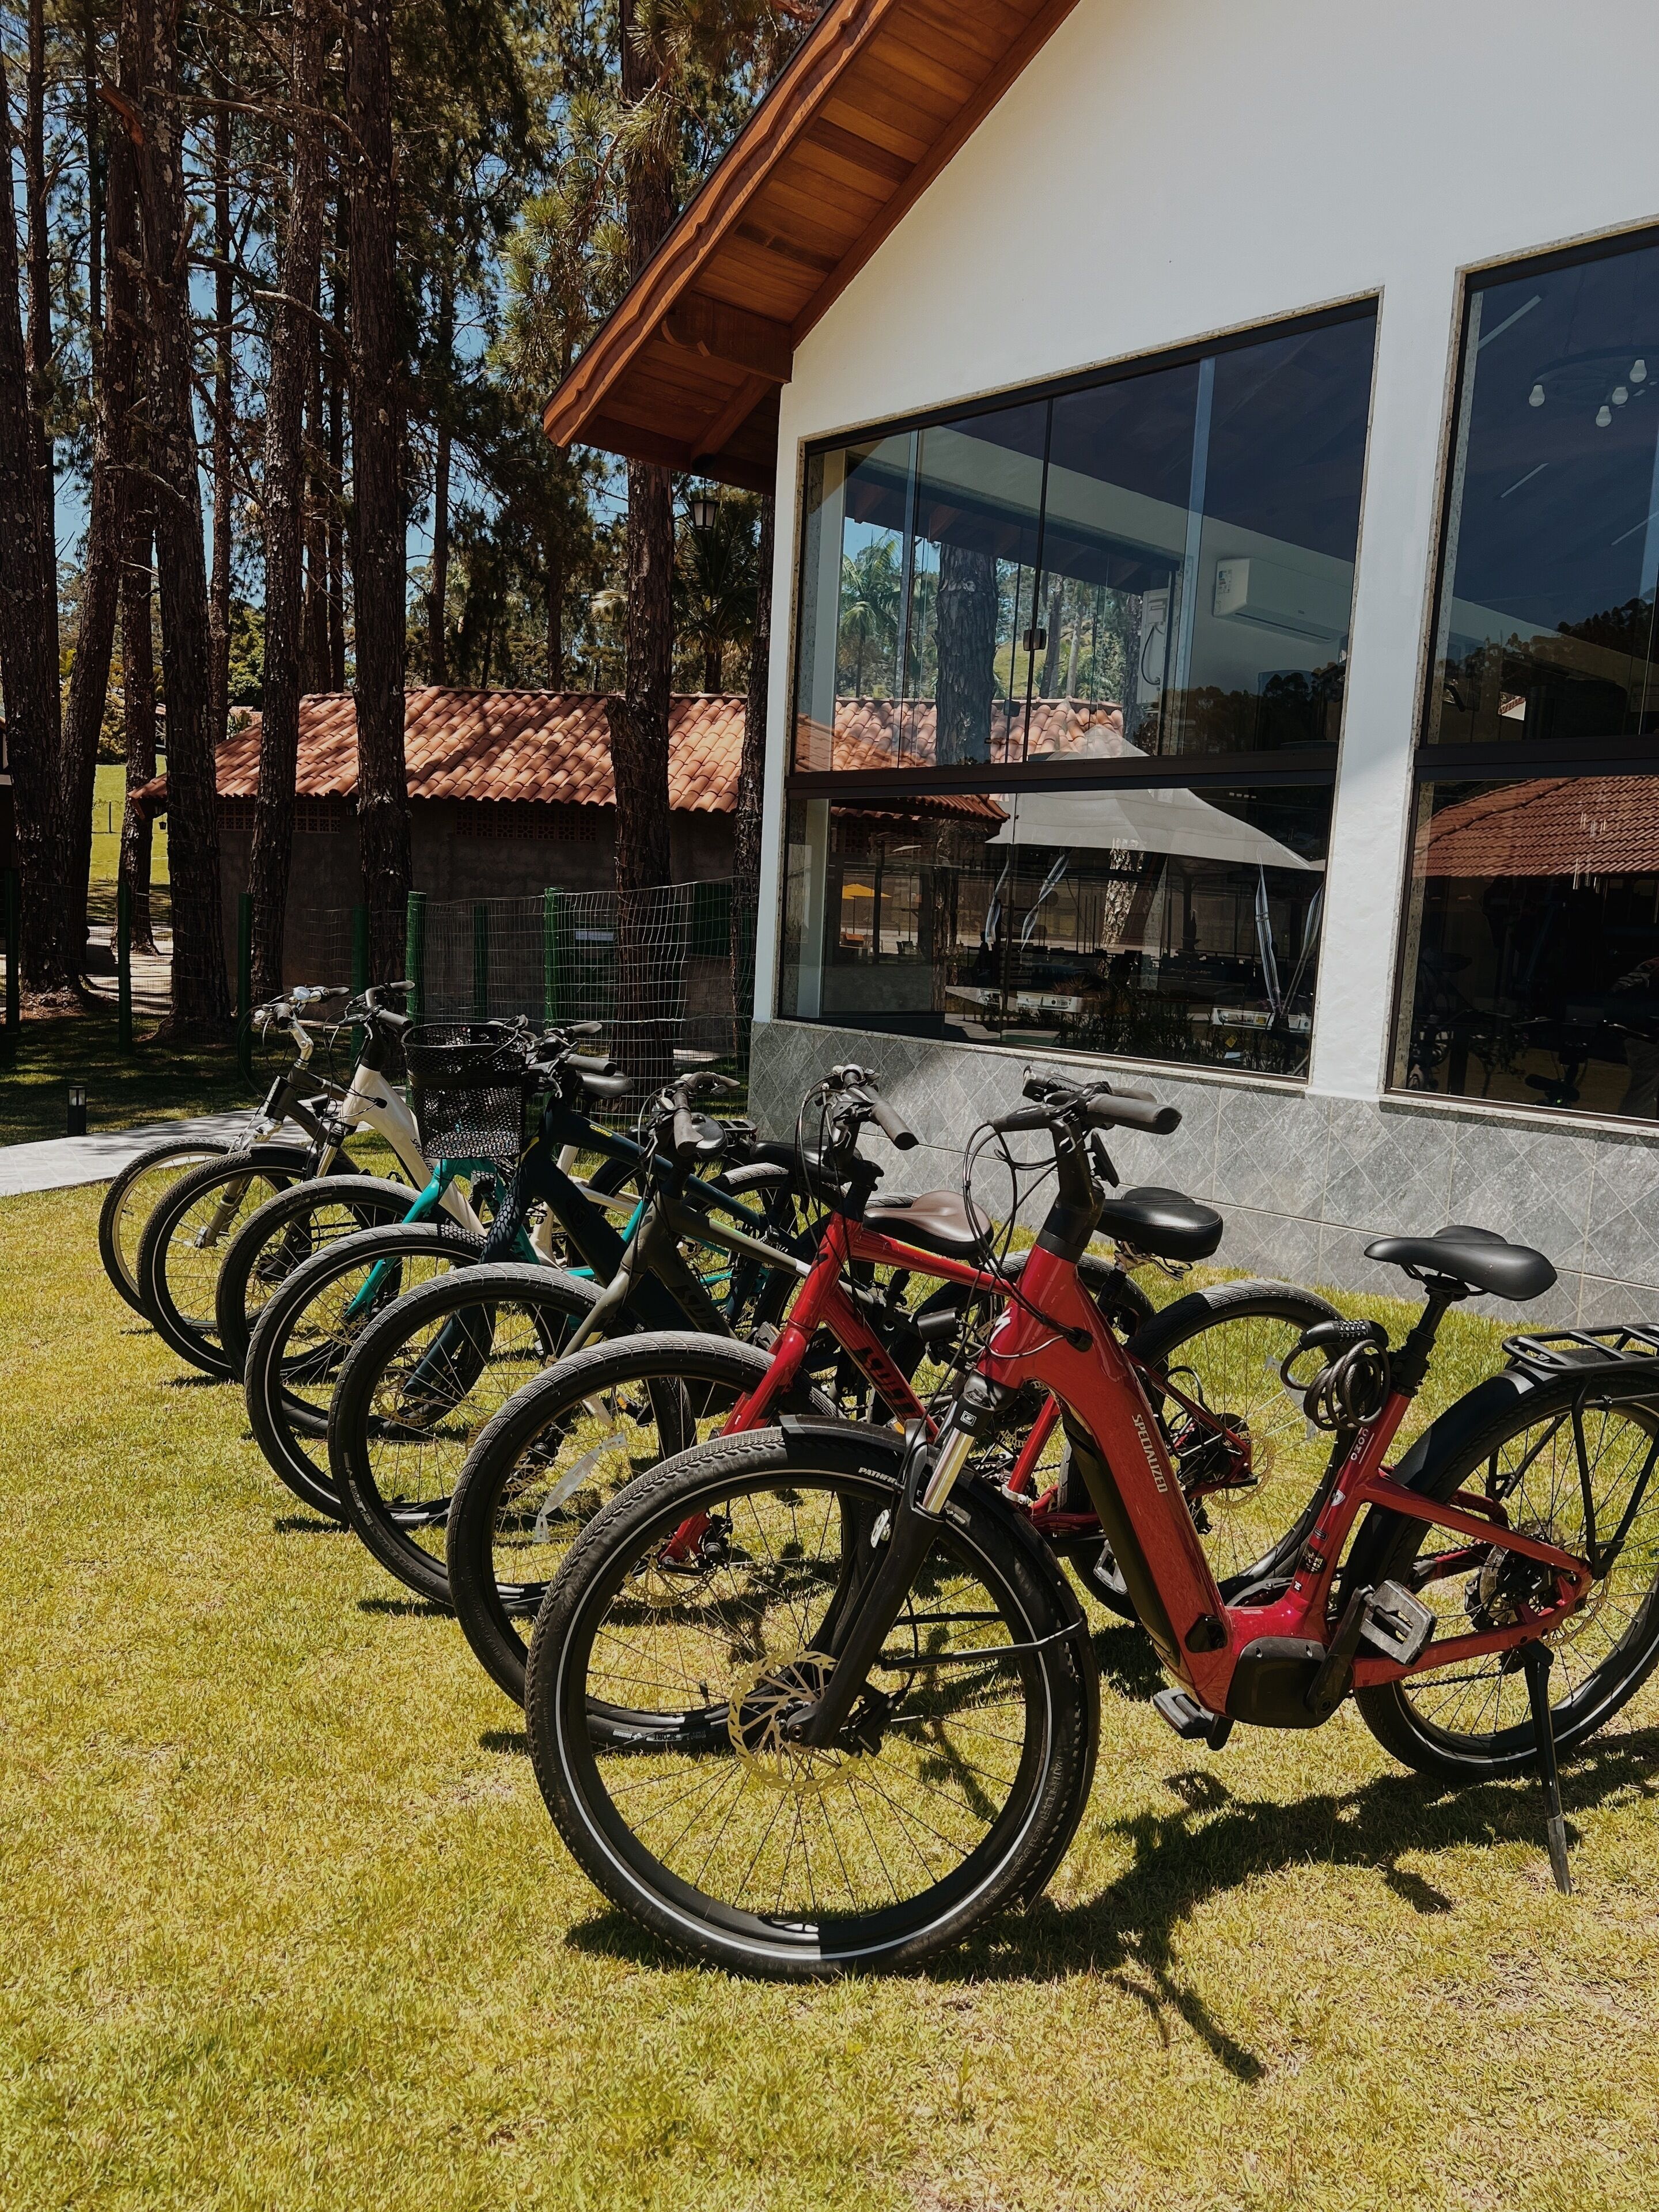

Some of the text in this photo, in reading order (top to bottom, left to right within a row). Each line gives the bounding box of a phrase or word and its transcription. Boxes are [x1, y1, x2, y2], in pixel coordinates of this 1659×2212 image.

[1131, 1414, 1168, 1493] SPECIALIZED
[1350, 1428, 1369, 1461] COMO
[351, 1483, 362, 1504] SPORT
